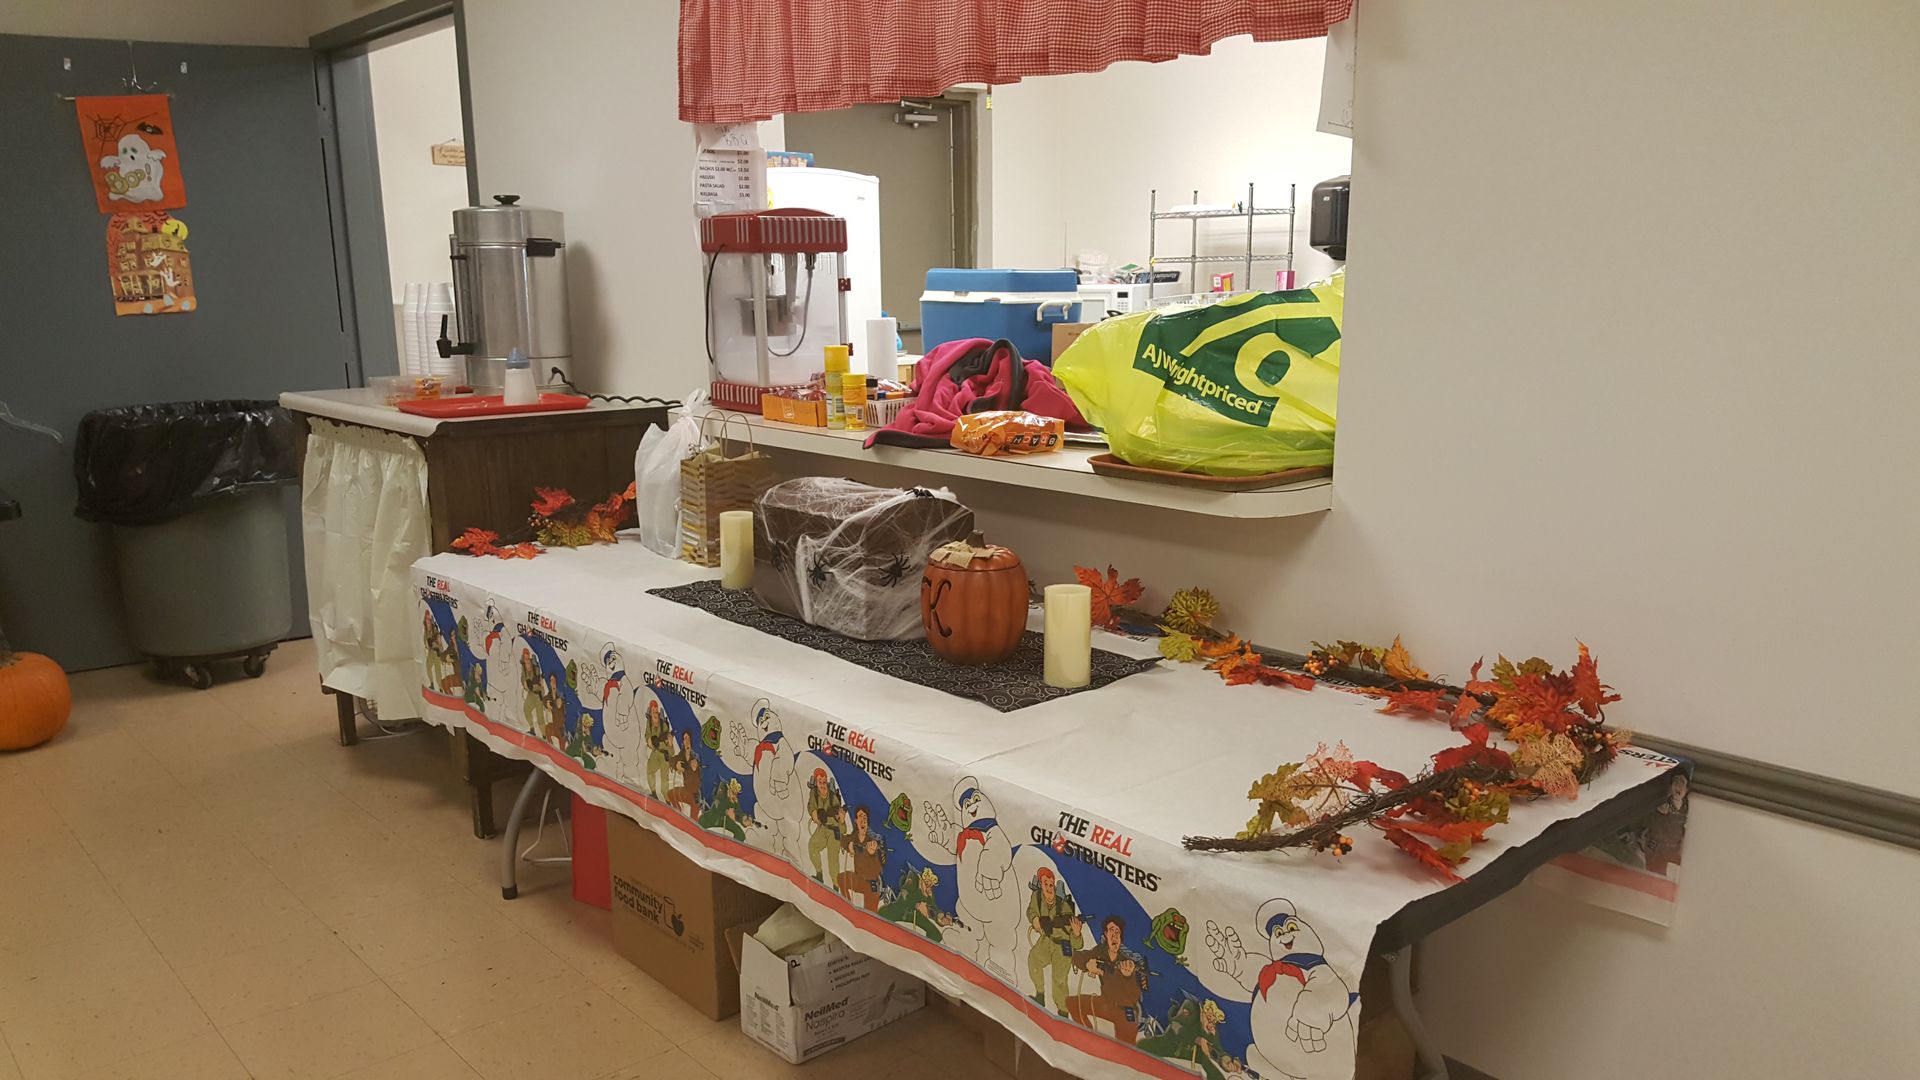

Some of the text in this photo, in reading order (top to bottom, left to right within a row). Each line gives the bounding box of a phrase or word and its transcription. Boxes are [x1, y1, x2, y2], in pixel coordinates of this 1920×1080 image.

[427, 576, 437, 588] THE
[528, 611, 557, 632] THE REAL
[656, 659, 694, 685] THE REAL
[826, 721, 876, 754] THE REAL
[1058, 811, 1133, 857] THE REAL
[613, 875, 662, 914] community
[614, 886, 659, 925] food bank
[804, 996, 849, 1021] NeilMed
